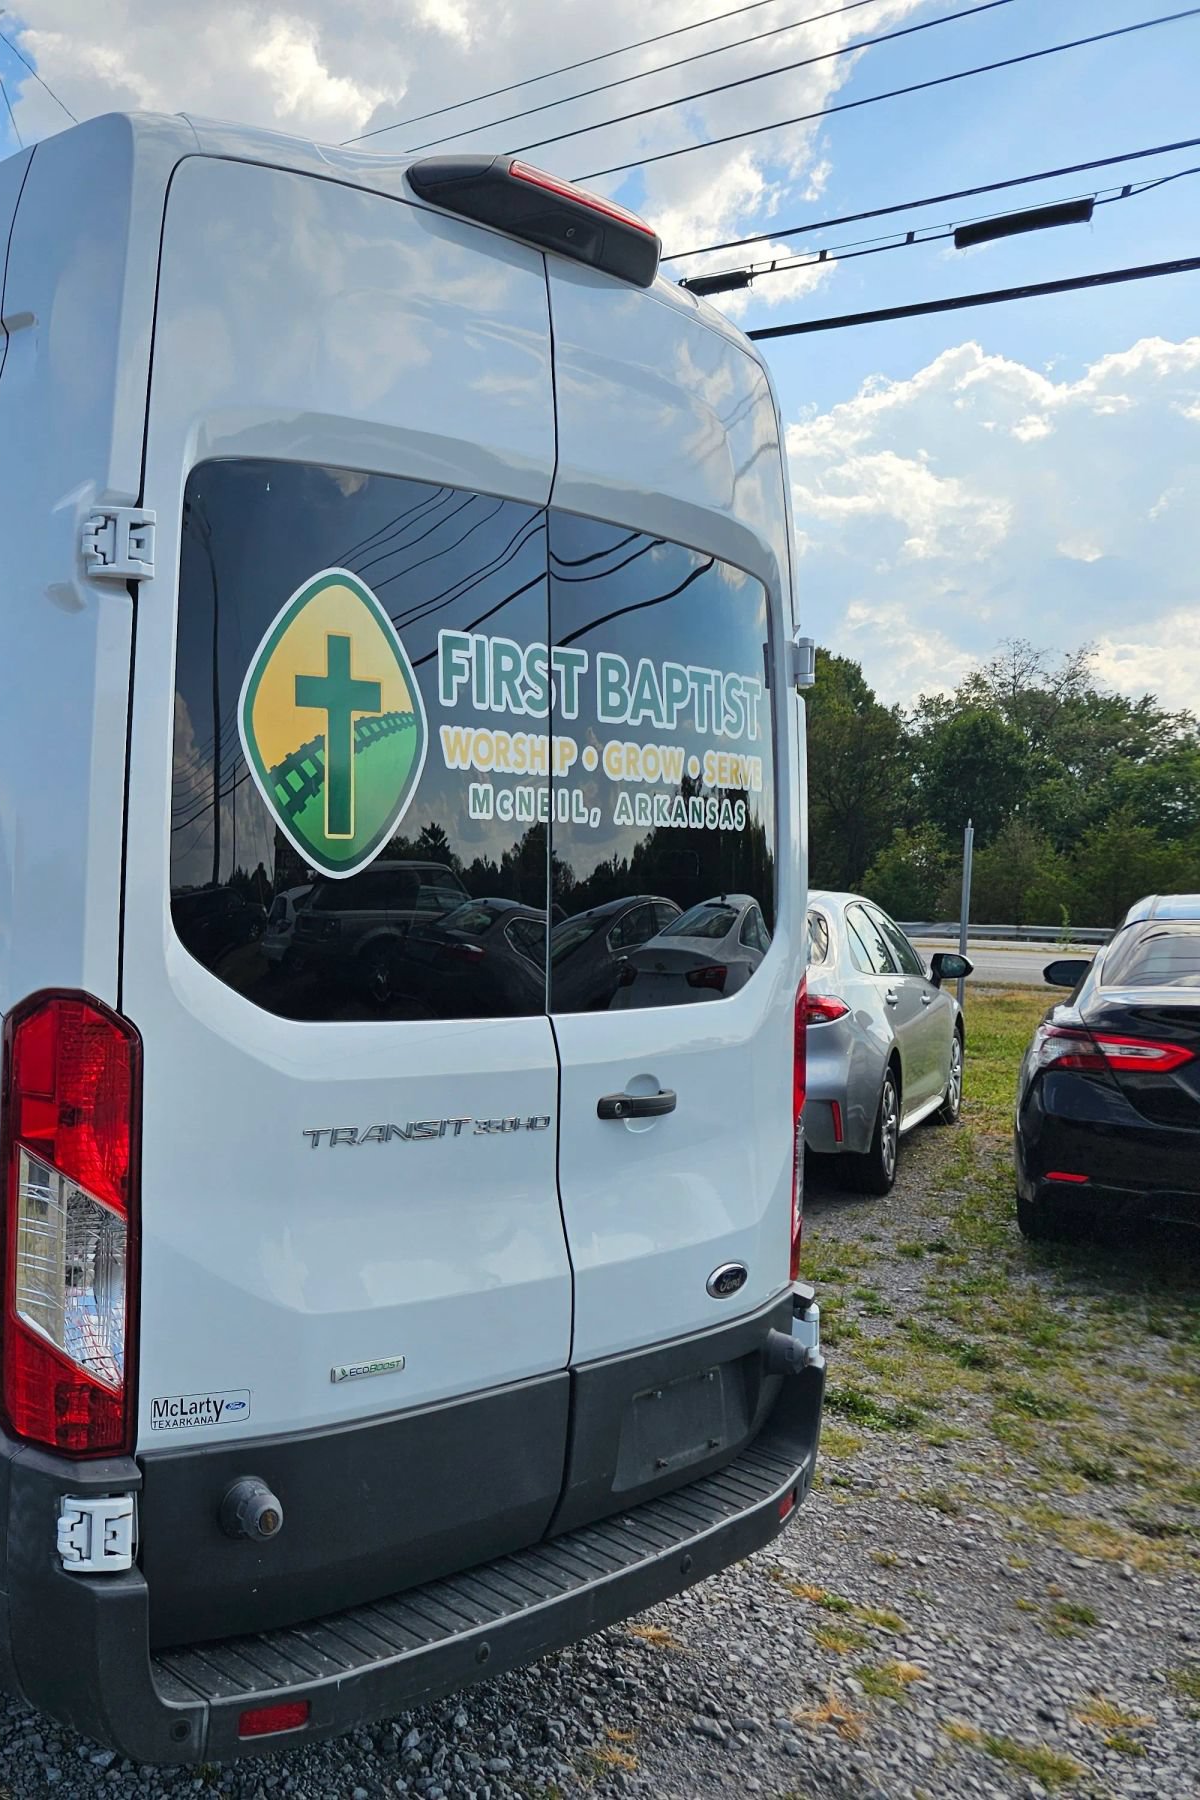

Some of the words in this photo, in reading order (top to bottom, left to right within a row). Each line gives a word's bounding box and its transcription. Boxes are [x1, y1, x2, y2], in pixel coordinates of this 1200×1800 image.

[438, 629, 588, 720] FIRST
[597, 652, 761, 741] BAPTIST
[439, 725, 578, 777] WORSHIP
[603, 740, 685, 784] GROW
[703, 749, 762, 792] SERVE
[613, 792, 746, 831] ARKANSAS
[302, 1117, 472, 1149] TRANSIT
[473, 1114, 551, 1136] 350HD
[153, 1397, 224, 1422] McLarty
[153, 1416, 214, 1429] TEXARKANA
